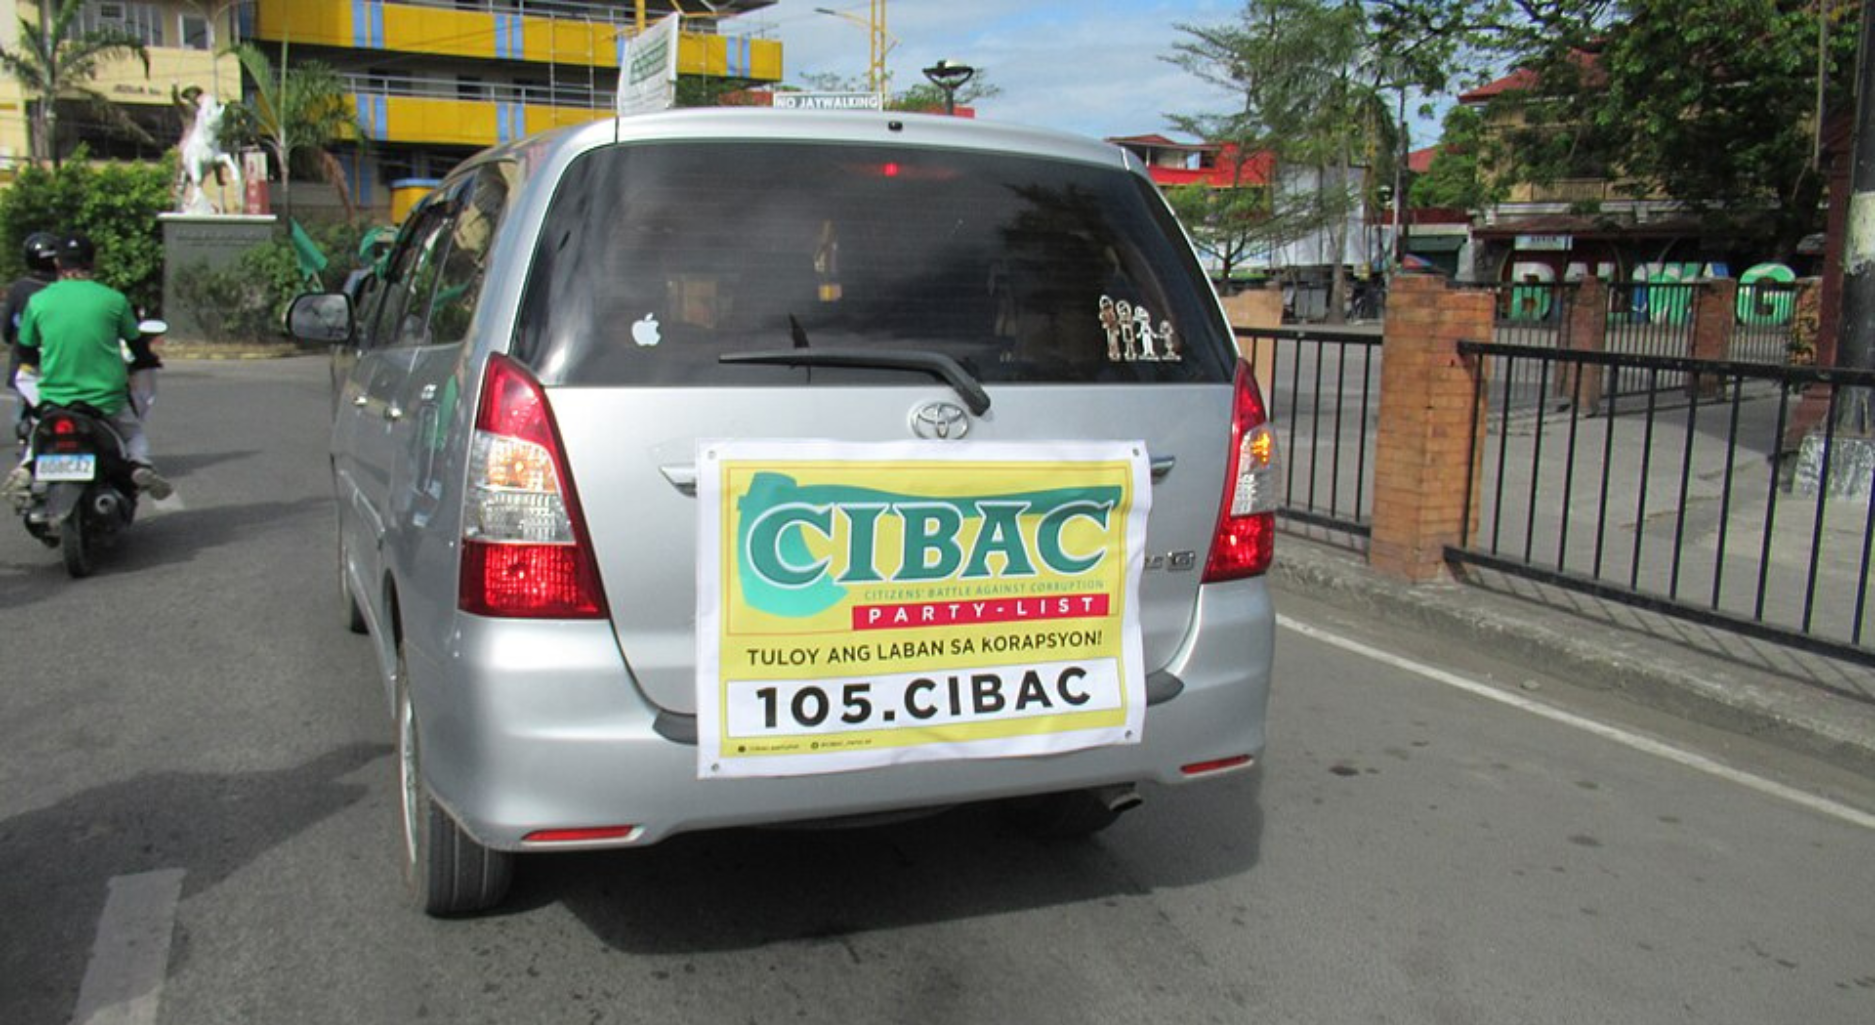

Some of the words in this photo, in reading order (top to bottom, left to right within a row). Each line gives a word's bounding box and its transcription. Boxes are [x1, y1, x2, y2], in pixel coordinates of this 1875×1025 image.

[776, 97, 796, 109] NO
[800, 96, 878, 109] JAYWALKING
[745, 500, 1115, 589] CIBAC
[864, 590, 926, 600] CITIZENS'
[928, 587, 971, 599] BATTLE
[976, 584, 1026, 596] AGAINST
[1030, 580, 1104, 592] CORRUPTION
[868, 597, 1094, 624] PARTY-LIST
[747, 648, 820, 665] TULOY
[828, 645, 871, 664] ANG
[877, 640, 945, 660] LABAN
[950, 638, 976, 655] SA
[981, 630, 1103, 653] KORAPSYON!
[756, 666, 1091, 729] 105.CIBAC
